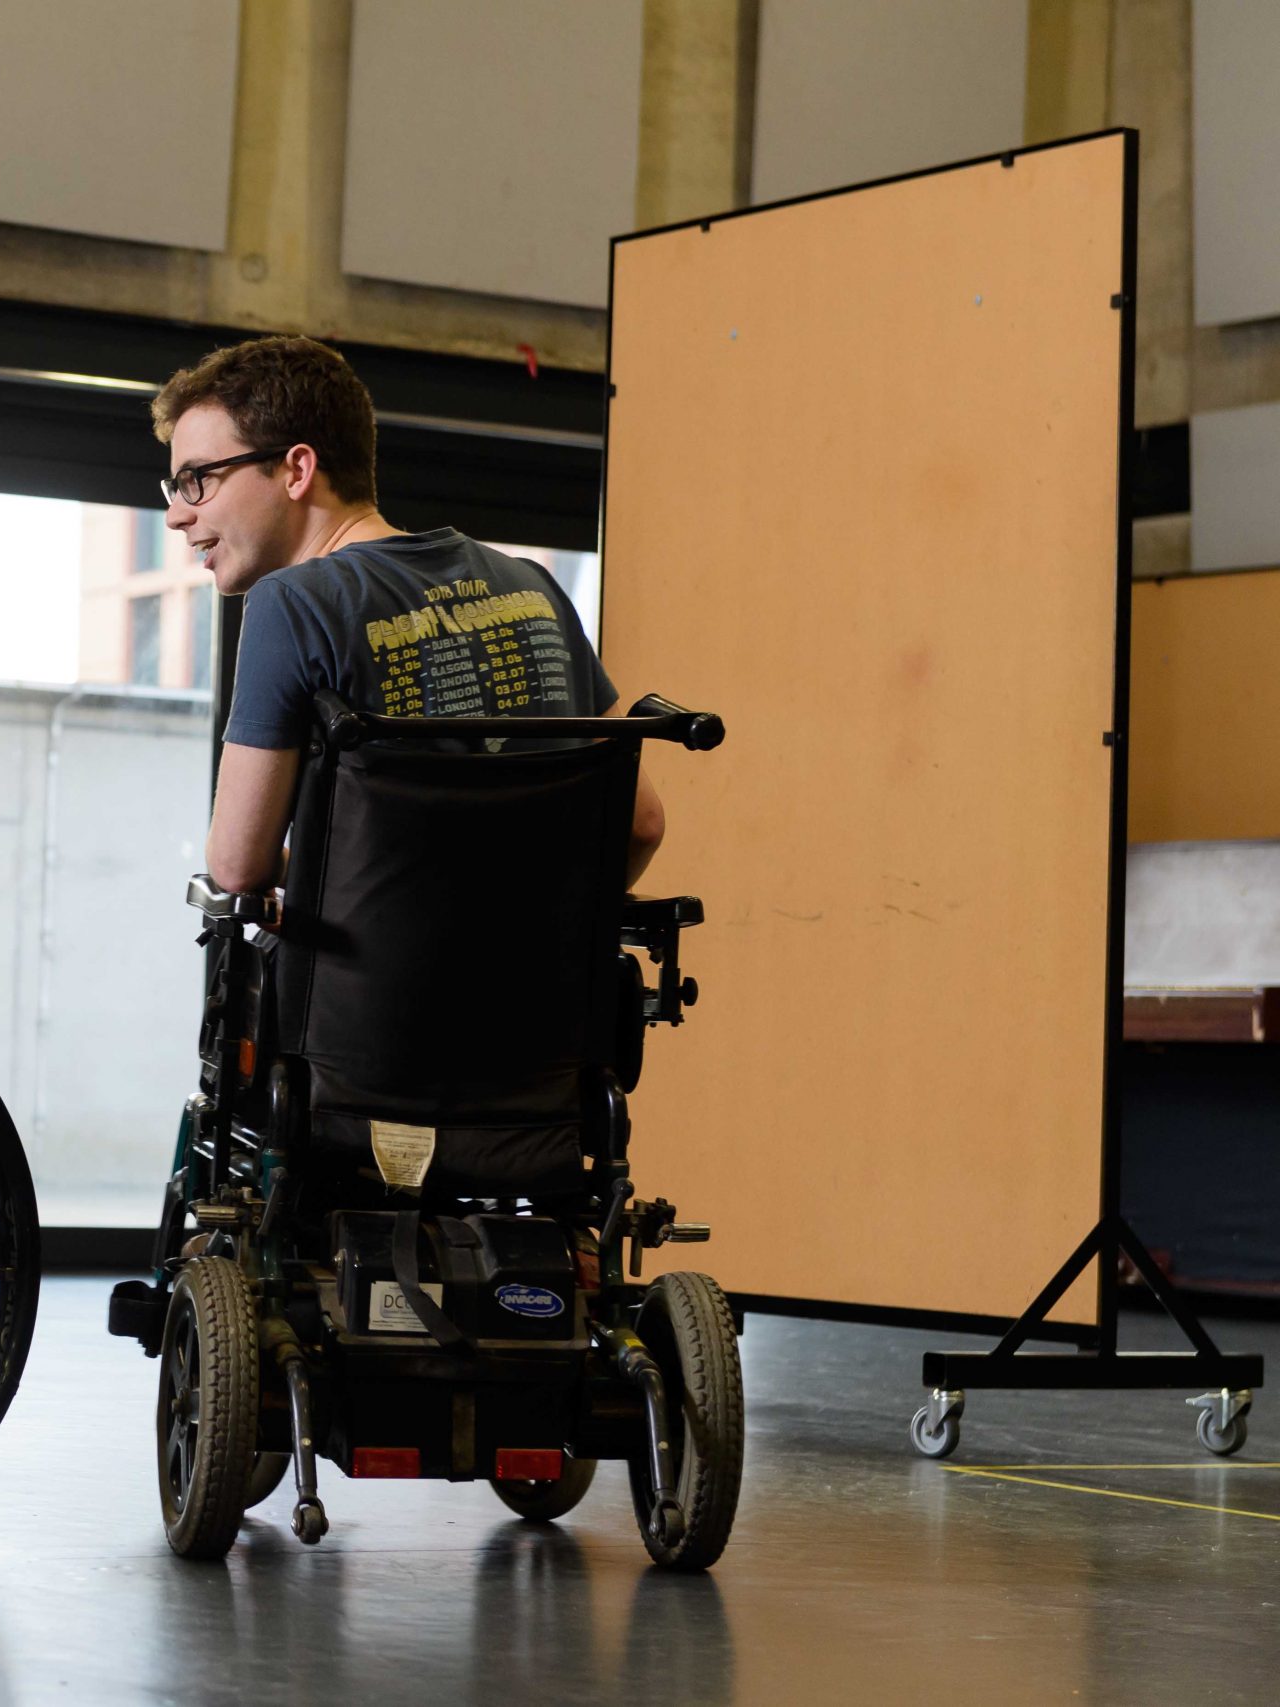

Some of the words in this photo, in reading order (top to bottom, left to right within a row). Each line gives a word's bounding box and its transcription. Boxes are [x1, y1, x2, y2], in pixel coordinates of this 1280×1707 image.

[452, 579, 491, 597] TOUR
[480, 627, 515, 642] 25.06
[386, 648, 420, 663] 15.06
[431, 635, 469, 651] DUBLIN
[485, 641, 519, 654] 26.06
[387, 660, 422, 676] 16.06
[433, 647, 471, 664] DUBLIN
[490, 653, 523, 668] 28.06
[492, 666, 525, 682] 02.07
[380, 675, 415, 691] 18.06
[384, 686, 422, 704] 20.06
[435, 672, 478, 689] LONDON
[495, 680, 528, 696] 03.07
[386, 699, 424, 716] 21.06
[436, 684, 481, 702] LONDON
[438, 696, 484, 715] LONDON
[497, 694, 530, 710] 04.07
